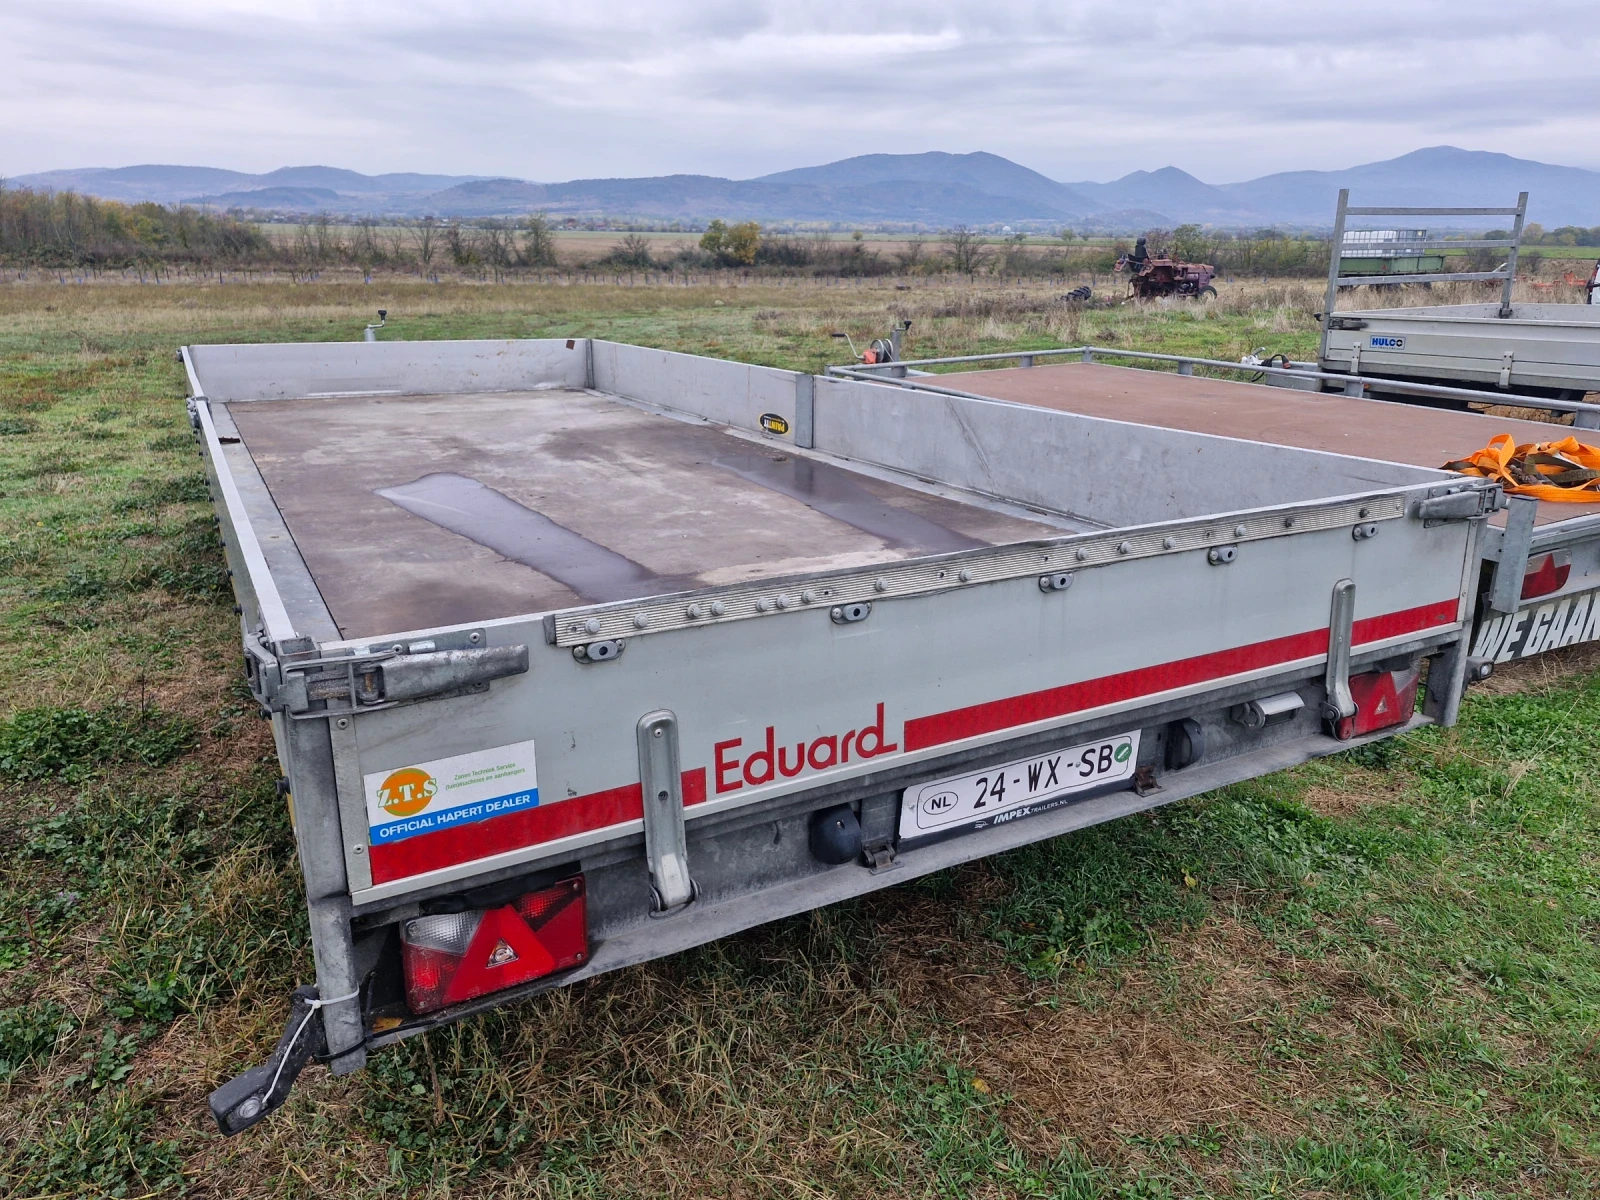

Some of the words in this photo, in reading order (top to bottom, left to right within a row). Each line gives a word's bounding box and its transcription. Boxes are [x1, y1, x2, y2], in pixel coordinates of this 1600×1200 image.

[1372, 337, 1403, 347] HULCO
[1471, 610, 1530, 665] WE
[472, 767, 495, 777] Techniek
[496, 762, 516, 771] Service
[714, 702, 898, 794] Eduard
[973, 744, 1113, 808] 24-WX-SB
[379, 820, 435, 838] OFFICIAL
[436, 805, 484, 825] HAPERT
[485, 794, 531, 813] DEALER
[931, 795, 952, 810] NL
